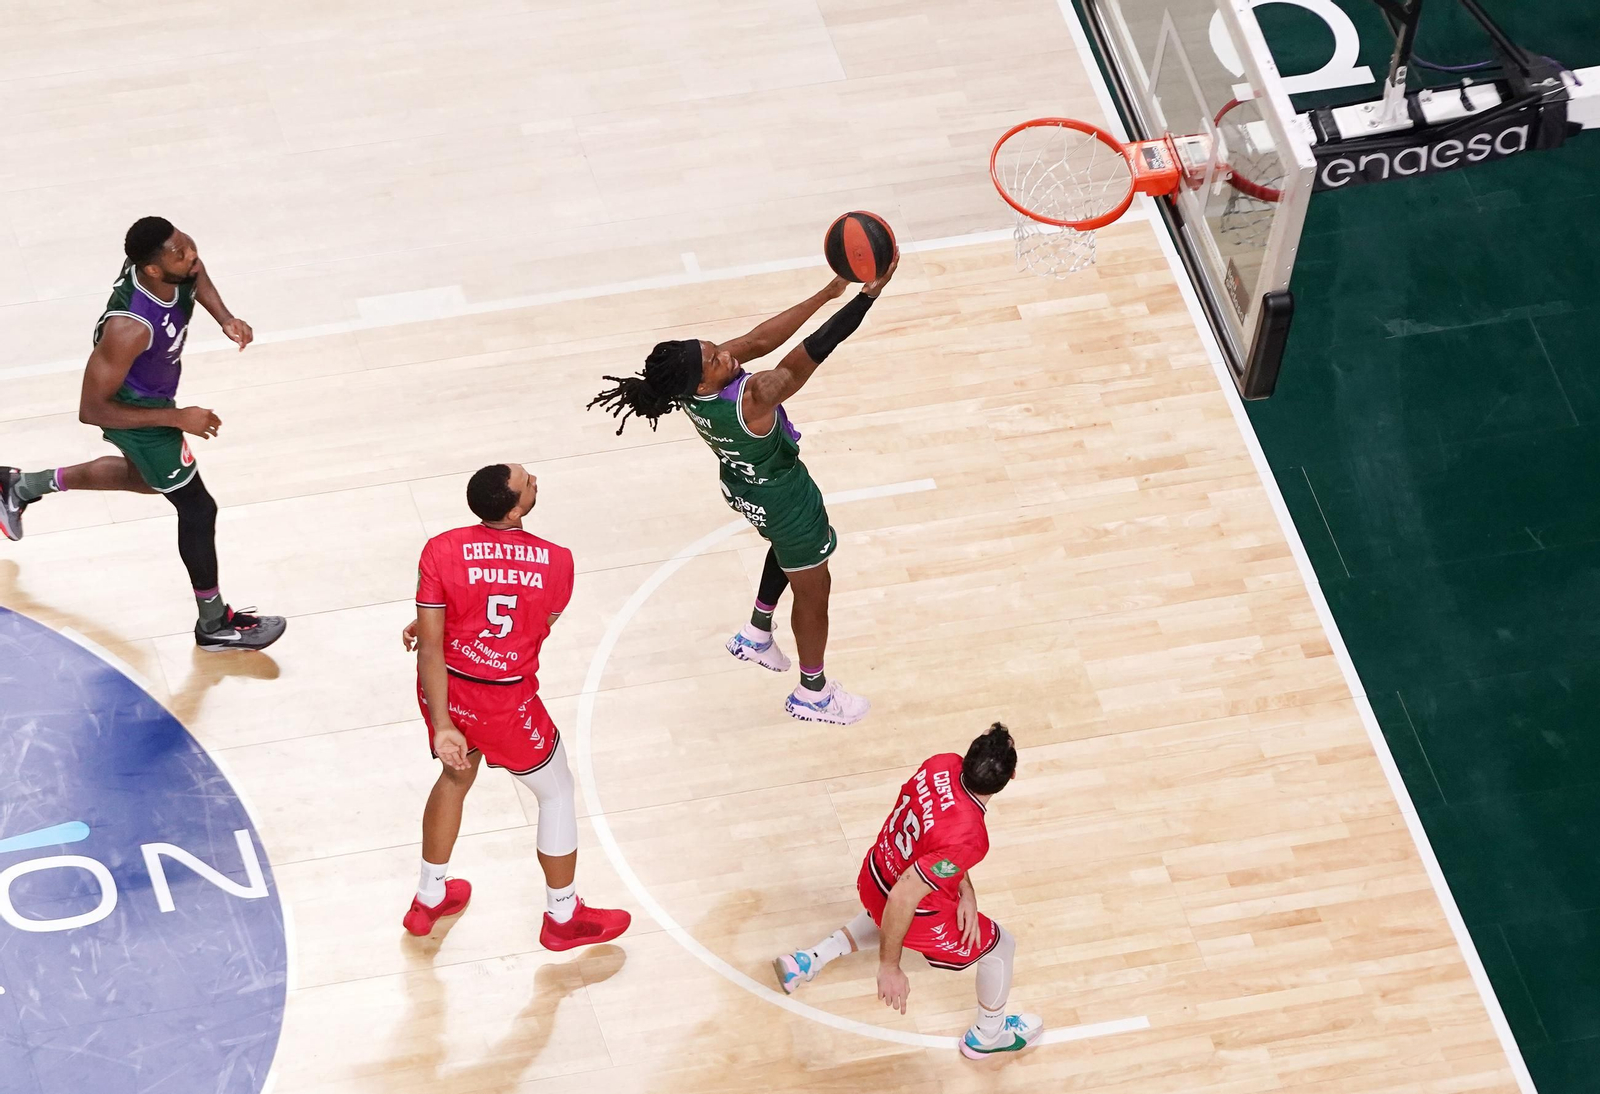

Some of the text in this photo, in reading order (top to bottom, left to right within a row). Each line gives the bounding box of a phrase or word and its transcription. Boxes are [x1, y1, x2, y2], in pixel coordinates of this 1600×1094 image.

[462, 542, 550, 565] CHEATHAM
[468, 567, 544, 589] PULEVA
[478, 594, 518, 639] 5
[933, 770, 956, 812] COSTA
